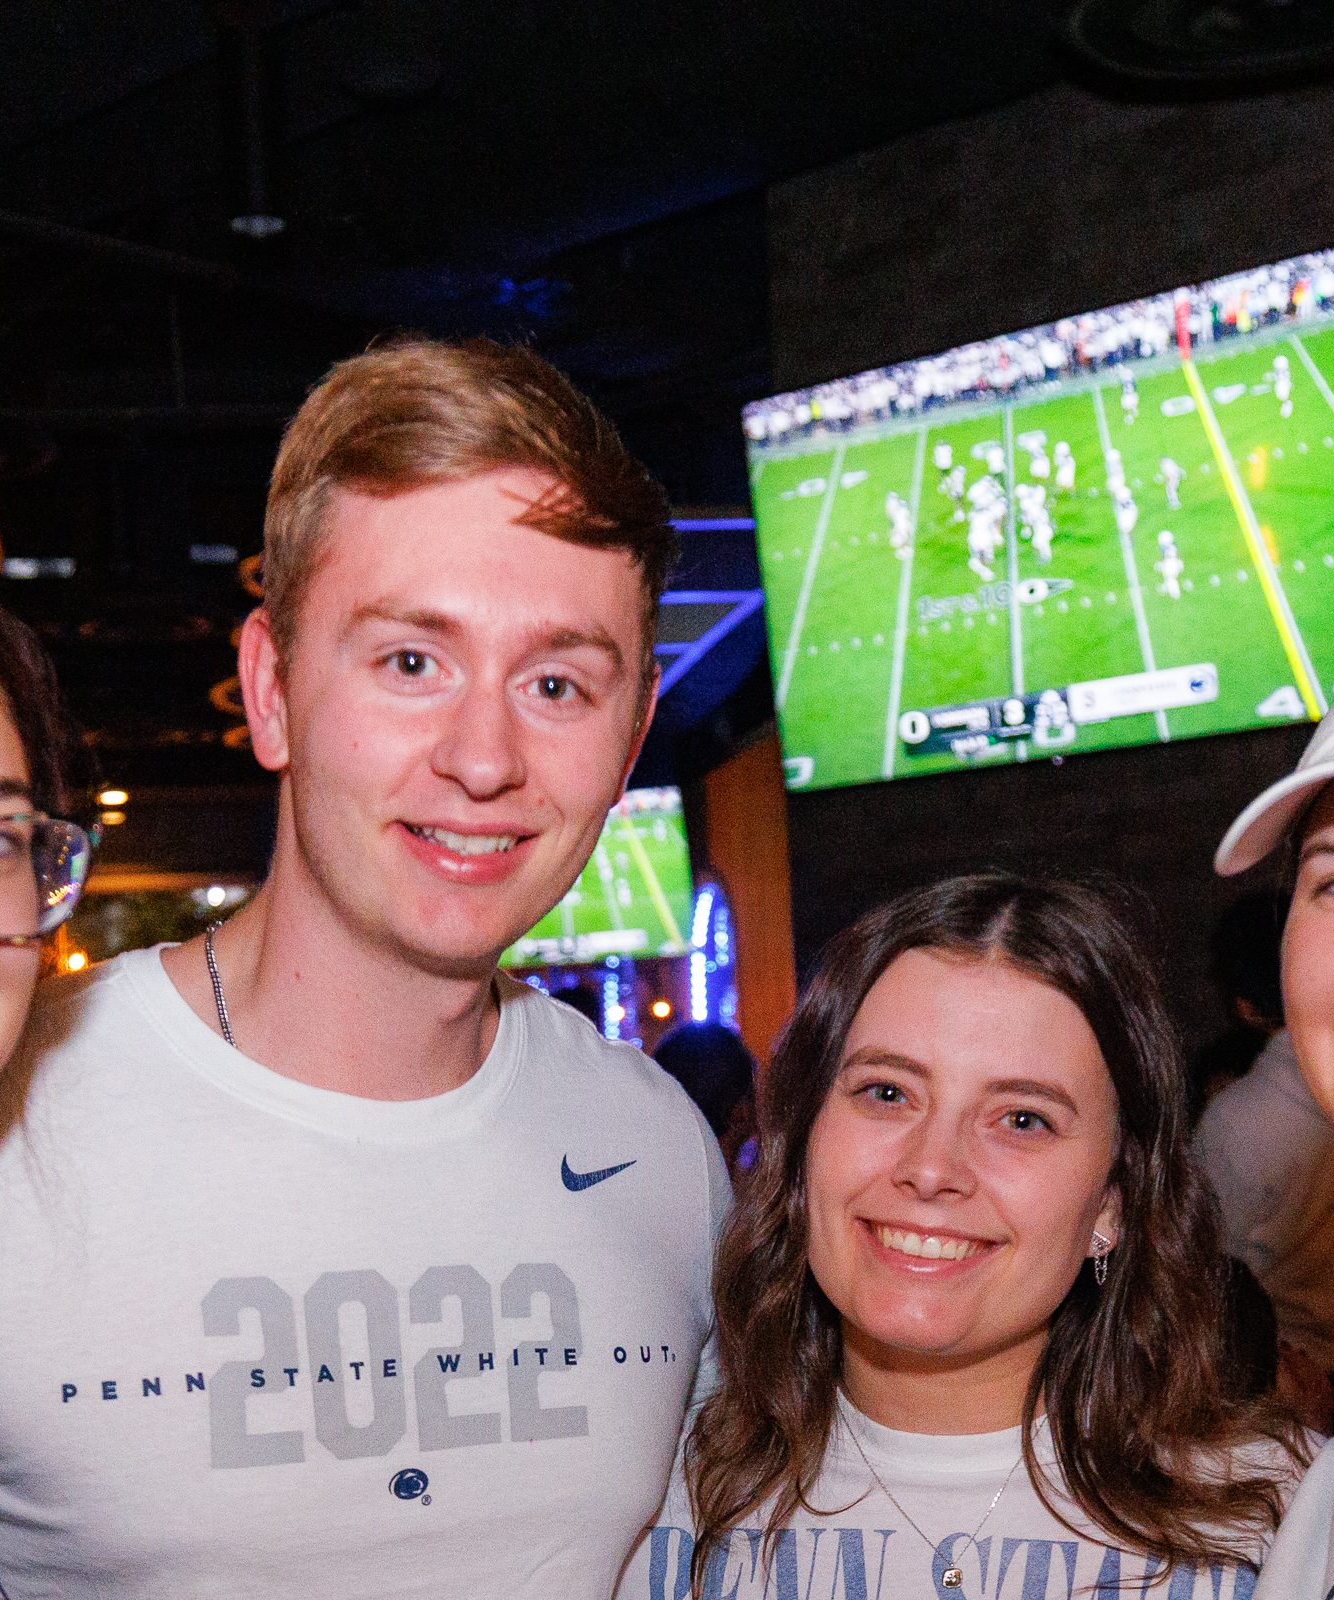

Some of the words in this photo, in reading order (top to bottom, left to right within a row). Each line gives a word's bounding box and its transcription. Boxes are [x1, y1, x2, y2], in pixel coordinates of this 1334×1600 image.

[61, 1372, 206, 1403] PENN
[250, 1359, 397, 1388] STATE
[437, 1347, 578, 1374] WHITE
[200, 1263, 589, 1469] 2022
